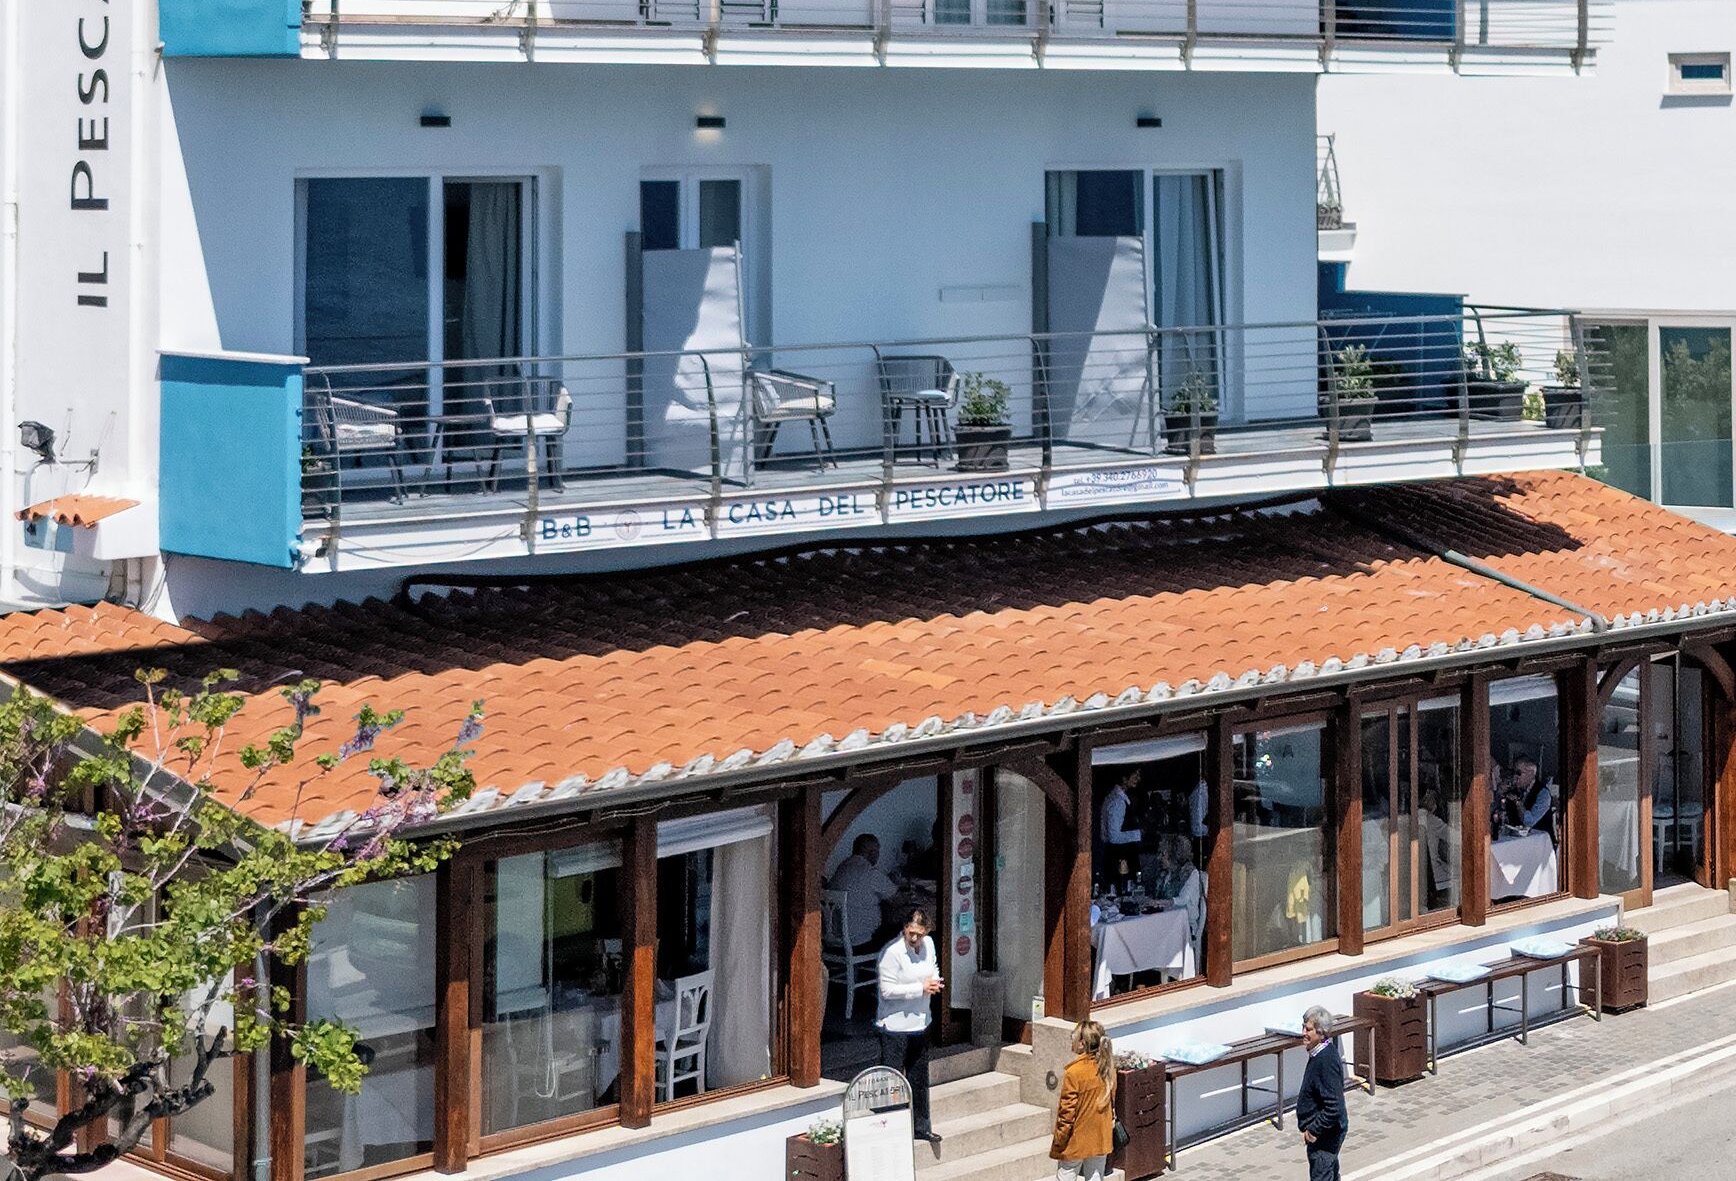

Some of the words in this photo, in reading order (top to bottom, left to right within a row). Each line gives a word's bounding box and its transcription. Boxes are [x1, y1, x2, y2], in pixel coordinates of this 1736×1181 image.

[77, 251, 108, 307] IL
[542, 515, 592, 540] B&B
[663, 507, 696, 530] LA
[728, 499, 796, 524] CASA
[819, 494, 864, 516] DEL
[896, 481, 1024, 509] PESCATORE
